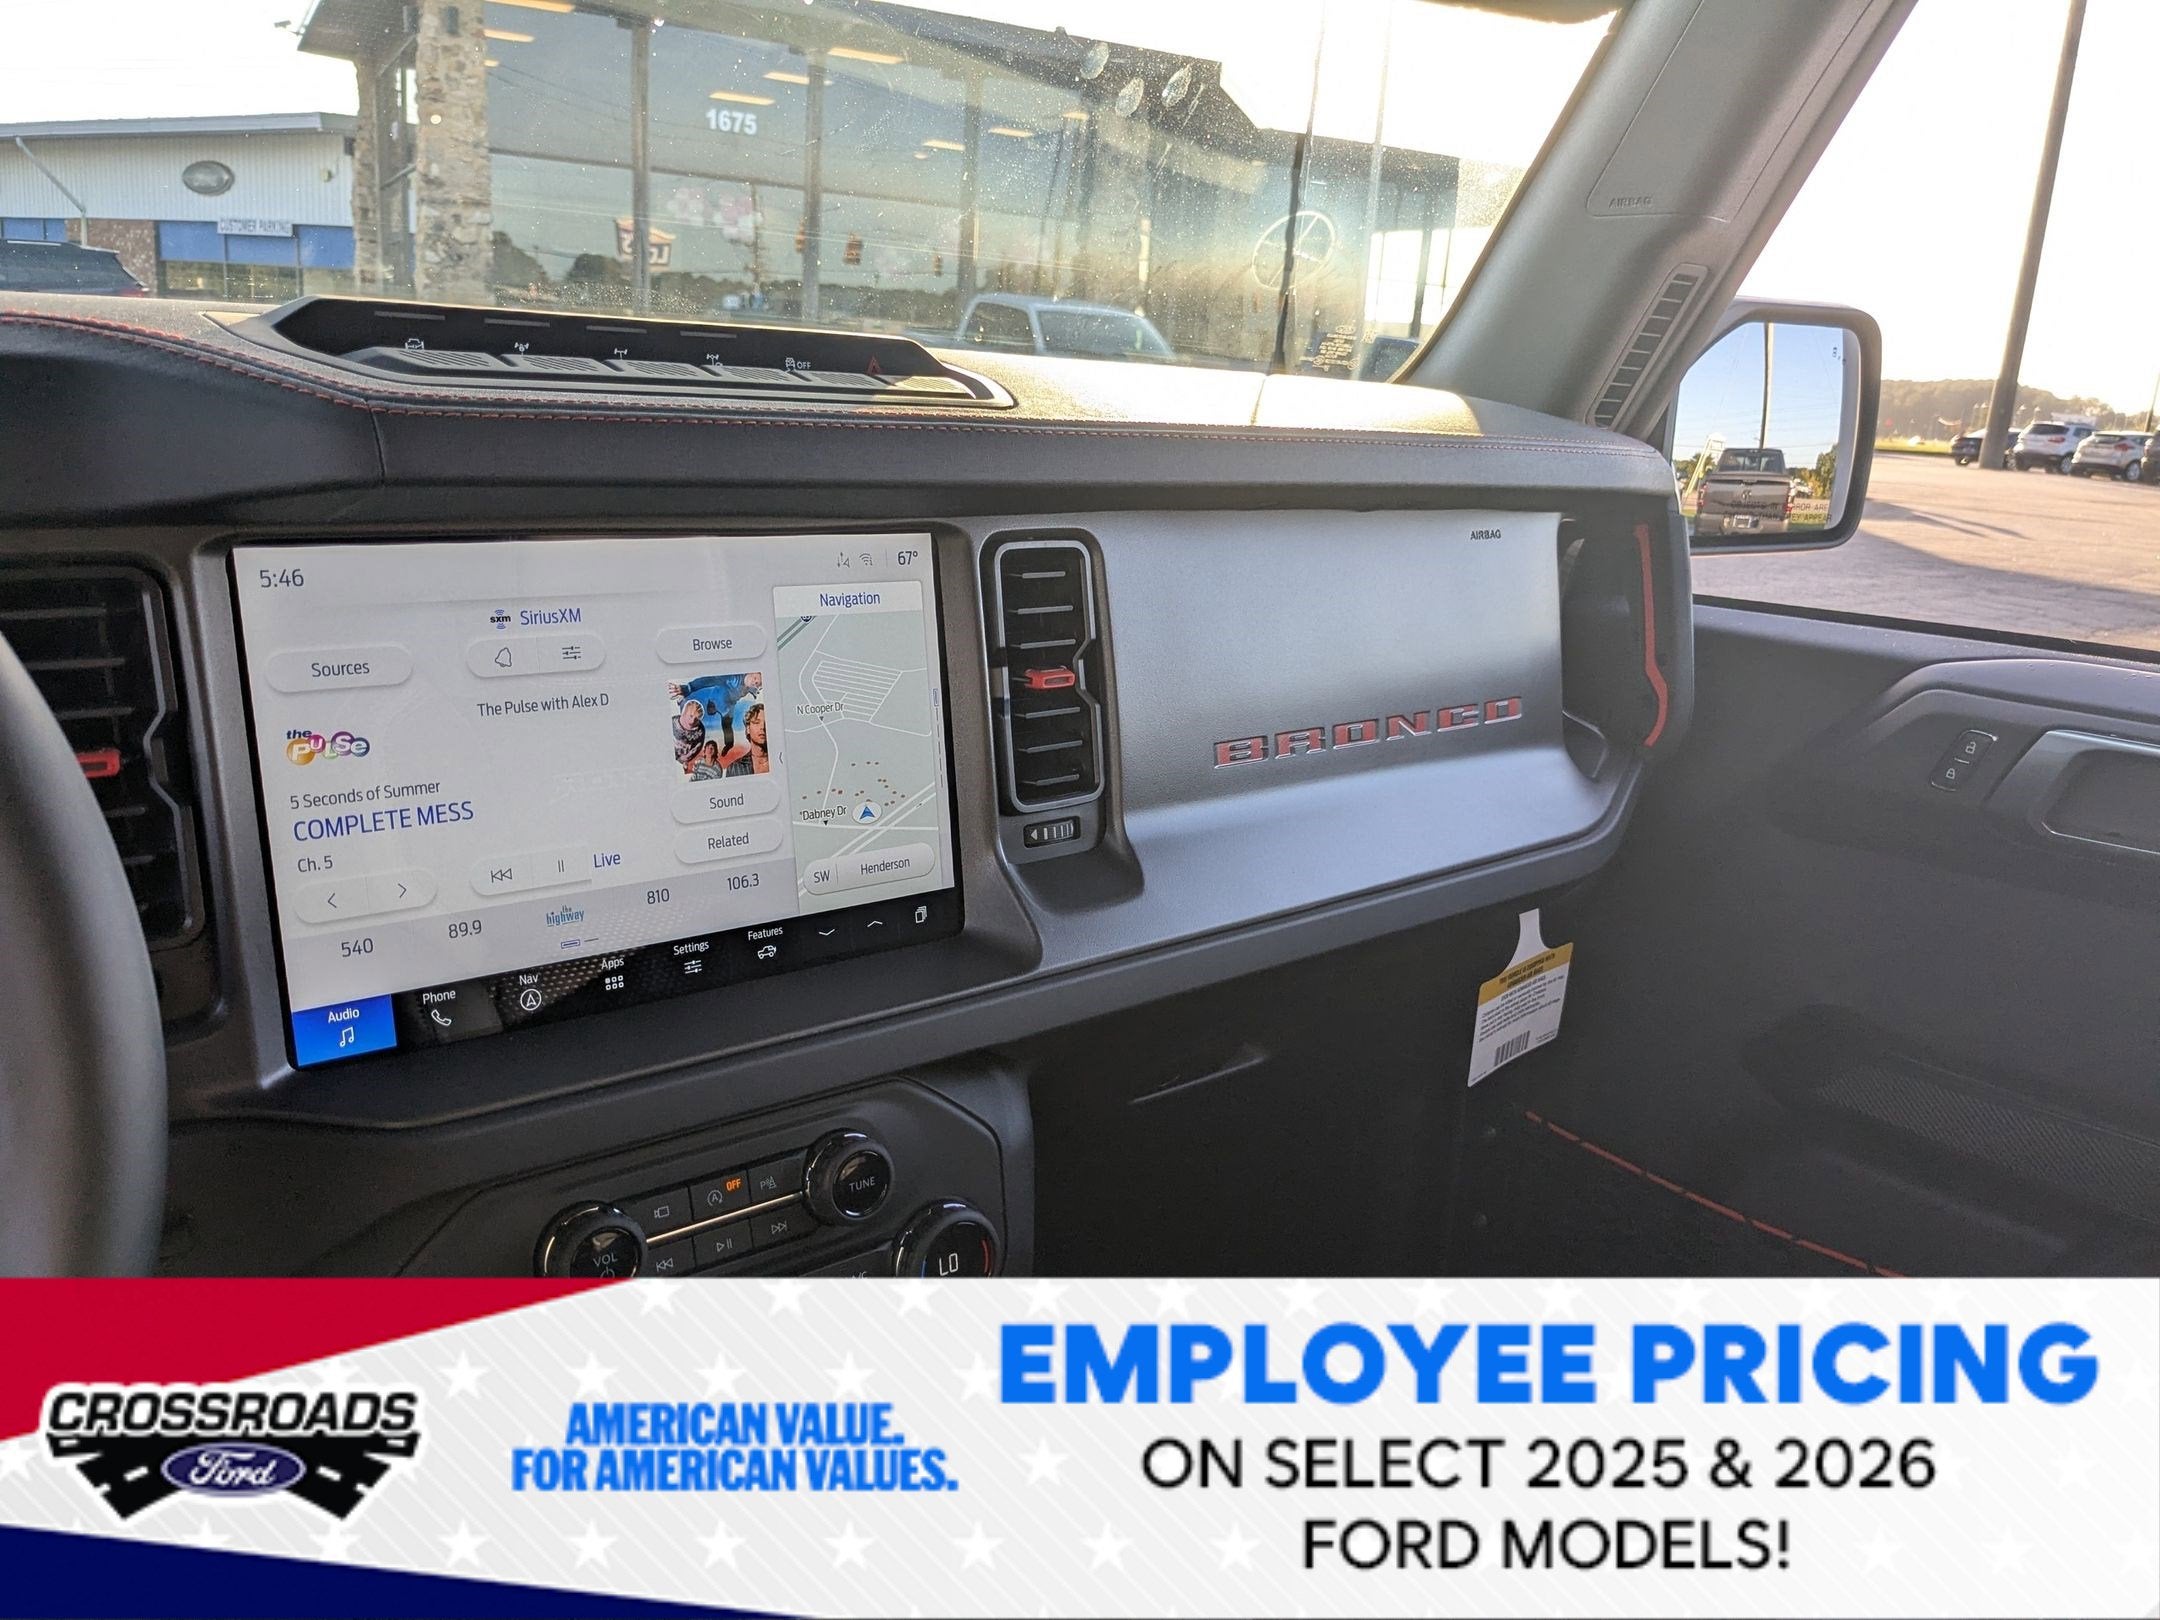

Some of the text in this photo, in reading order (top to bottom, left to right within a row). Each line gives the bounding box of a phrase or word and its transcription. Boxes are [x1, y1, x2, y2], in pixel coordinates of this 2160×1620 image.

[705, 108, 758, 136] 1675
[796, 361, 811, 369] OFF
[1470, 528, 1502, 541] AIRBAG
[259, 568, 305, 588] 5:46
[819, 592, 881, 608] Navigation
[489, 614, 512, 624] sxm
[520, 607, 582, 626] SiriusXM
[692, 637, 733, 651] Browse
[311, 659, 370, 678] Sources
[477, 693, 609, 717] The Pulse with Alex D
[796, 701, 845, 716] N Cooper Dr
[286, 729, 312, 740] the
[1213, 696, 1522, 769] BRONCO
[289, 781, 441, 810] 5 Seconds of Summer
[708, 793, 745, 811] Sound
[292, 800, 475, 842] COMPLETE MESS
[802, 805, 847, 821] Dabney Dr
[707, 832, 750, 851] Related
[296, 855, 334, 874] Ch. 5
[593, 852, 622, 869] Live
[813, 857, 911, 884] SW Henderson
[726, 873, 760, 892] 106.3
[646, 888, 670, 905] 810
[561, 904, 573, 914] the
[545, 910, 585, 927] highway
[447, 919, 483, 939] 89.9
[747, 925, 784, 941] Features
[340, 937, 375, 958] 540
[673, 940, 710, 957] Settings
[600, 956, 625, 971] Apps
[518, 973, 539, 986] Nav
[422, 988, 456, 1004] Phone
[327, 1007, 361, 1024] Audio
[725, 1177, 742, 1192] OFF
[849, 1176, 876, 1193] TUNE
[592, 1251, 619, 1267] VOL
[938, 1252, 959, 1277] LO
